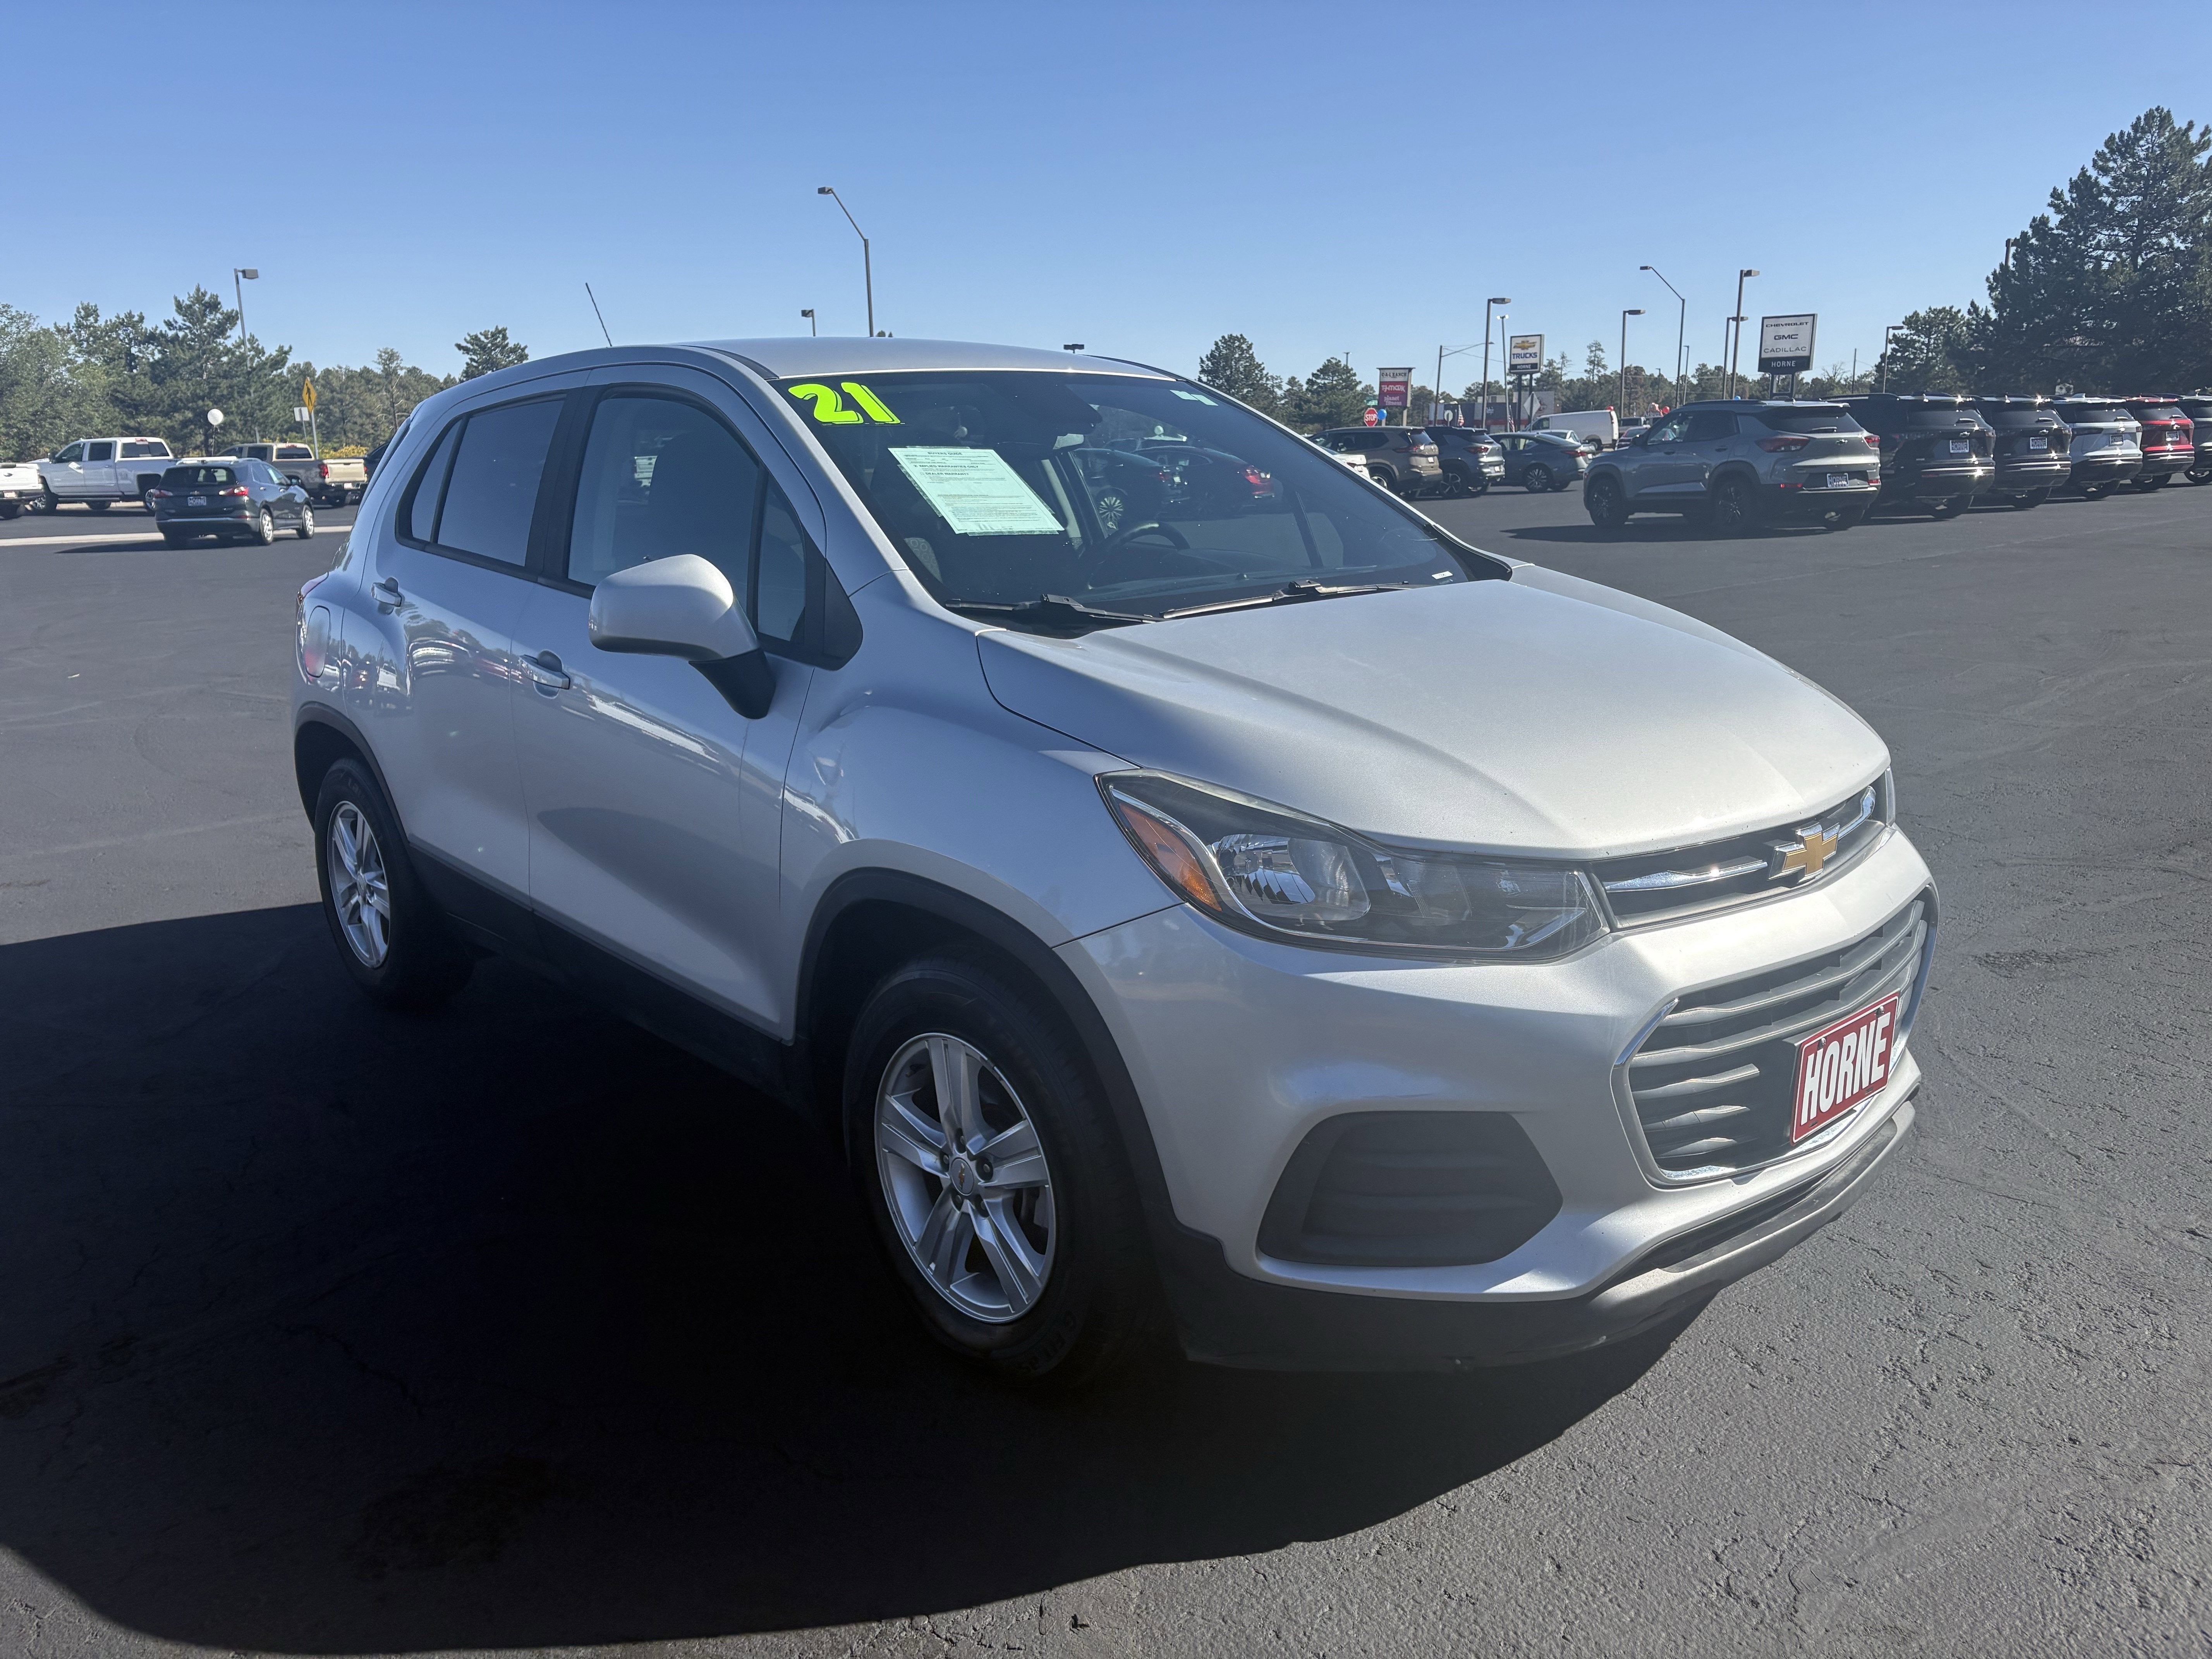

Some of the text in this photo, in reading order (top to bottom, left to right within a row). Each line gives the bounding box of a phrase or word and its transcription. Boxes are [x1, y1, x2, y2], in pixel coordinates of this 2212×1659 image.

[788, 382, 901, 424] 21
[1829, 476, 1847, 484] HORNE
[1801, 1012, 1891, 1126] HORNE
